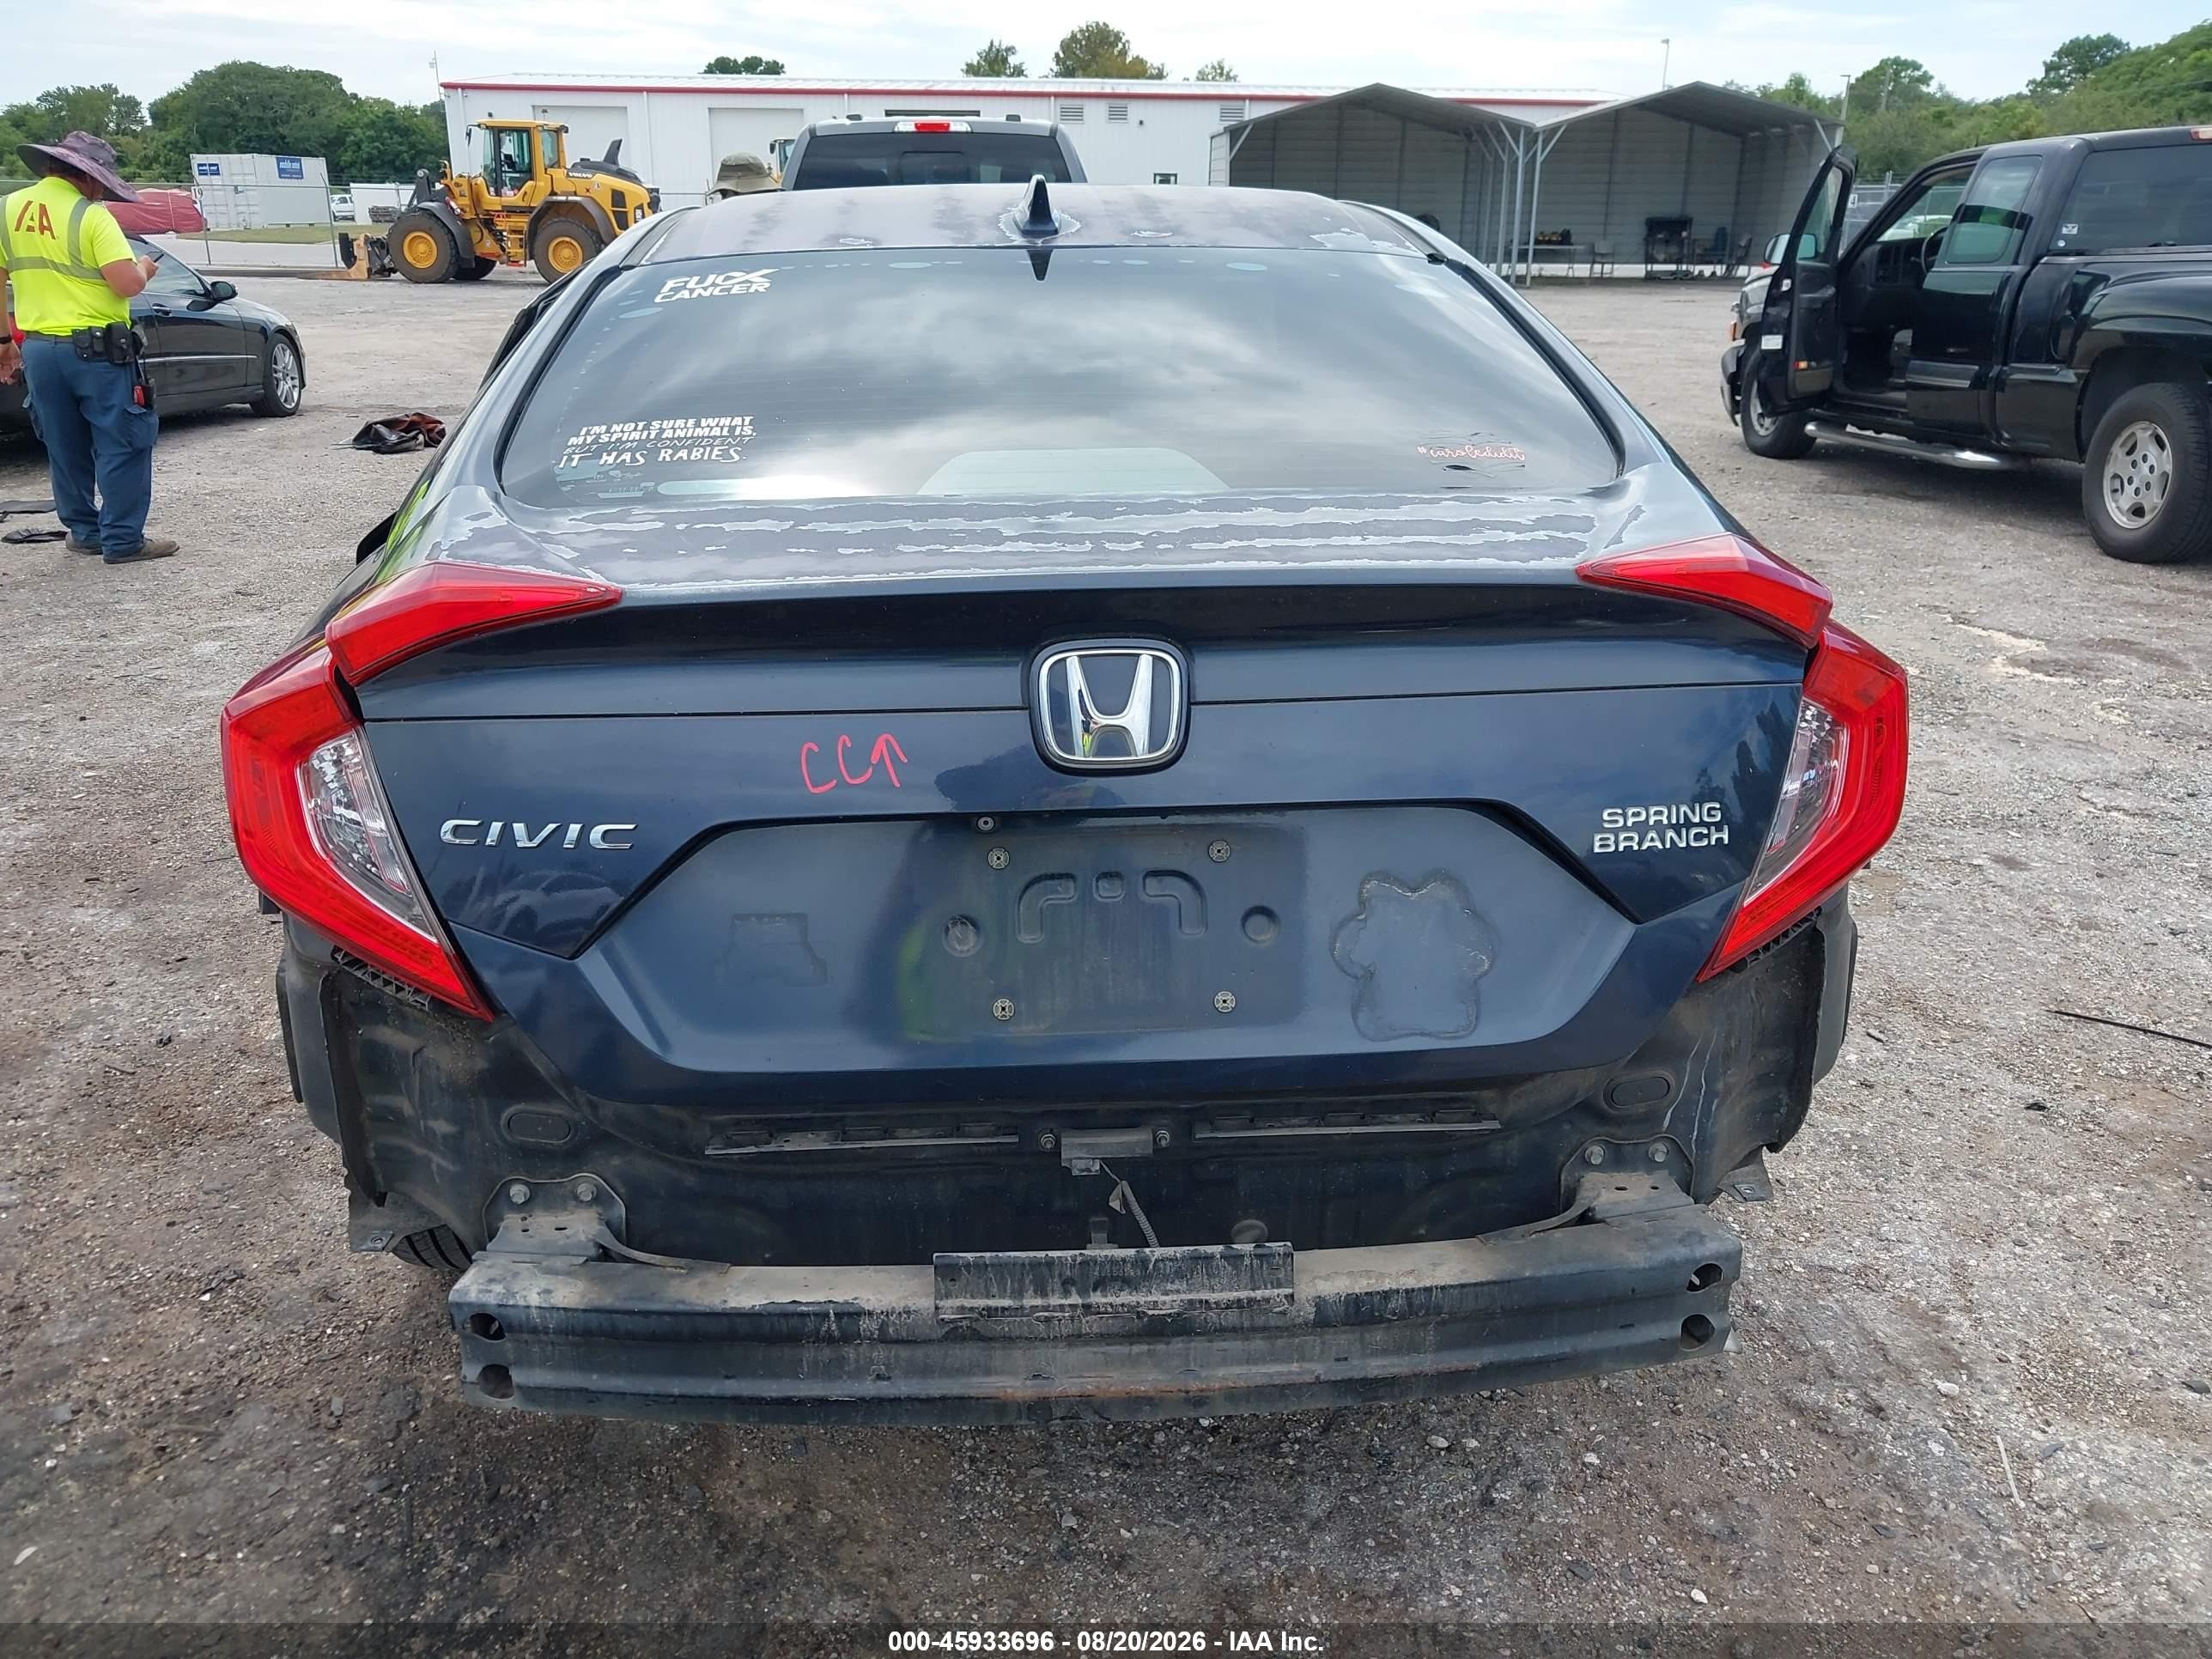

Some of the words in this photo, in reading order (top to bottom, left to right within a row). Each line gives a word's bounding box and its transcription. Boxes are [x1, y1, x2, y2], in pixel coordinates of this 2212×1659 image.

[192, 187, 204, 198] 19
[654, 282, 771, 303] CANCER
[567, 434, 597, 447] MY
[599, 430, 660, 443] SPIRIT
[660, 427, 729, 440] ANIMAL
[734, 426, 757, 437] IS.
[580, 425, 607, 436] I'M
[611, 421, 648, 434] NOT
[651, 418, 698, 430] SURE
[700, 416, 754, 428] WHAT
[562, 444, 602, 455] BUT
[606, 441, 639, 451] I'M
[646, 436, 757, 449] CONFIDENT
[558, 453, 593, 469] IT
[599, 450, 648, 466] HAS
[657, 446, 749, 463] RABIES.
[1601, 801, 1722, 829] SPRING
[439, 818, 639, 849] CIVIC
[1593, 824, 1729, 854] BRANCH
